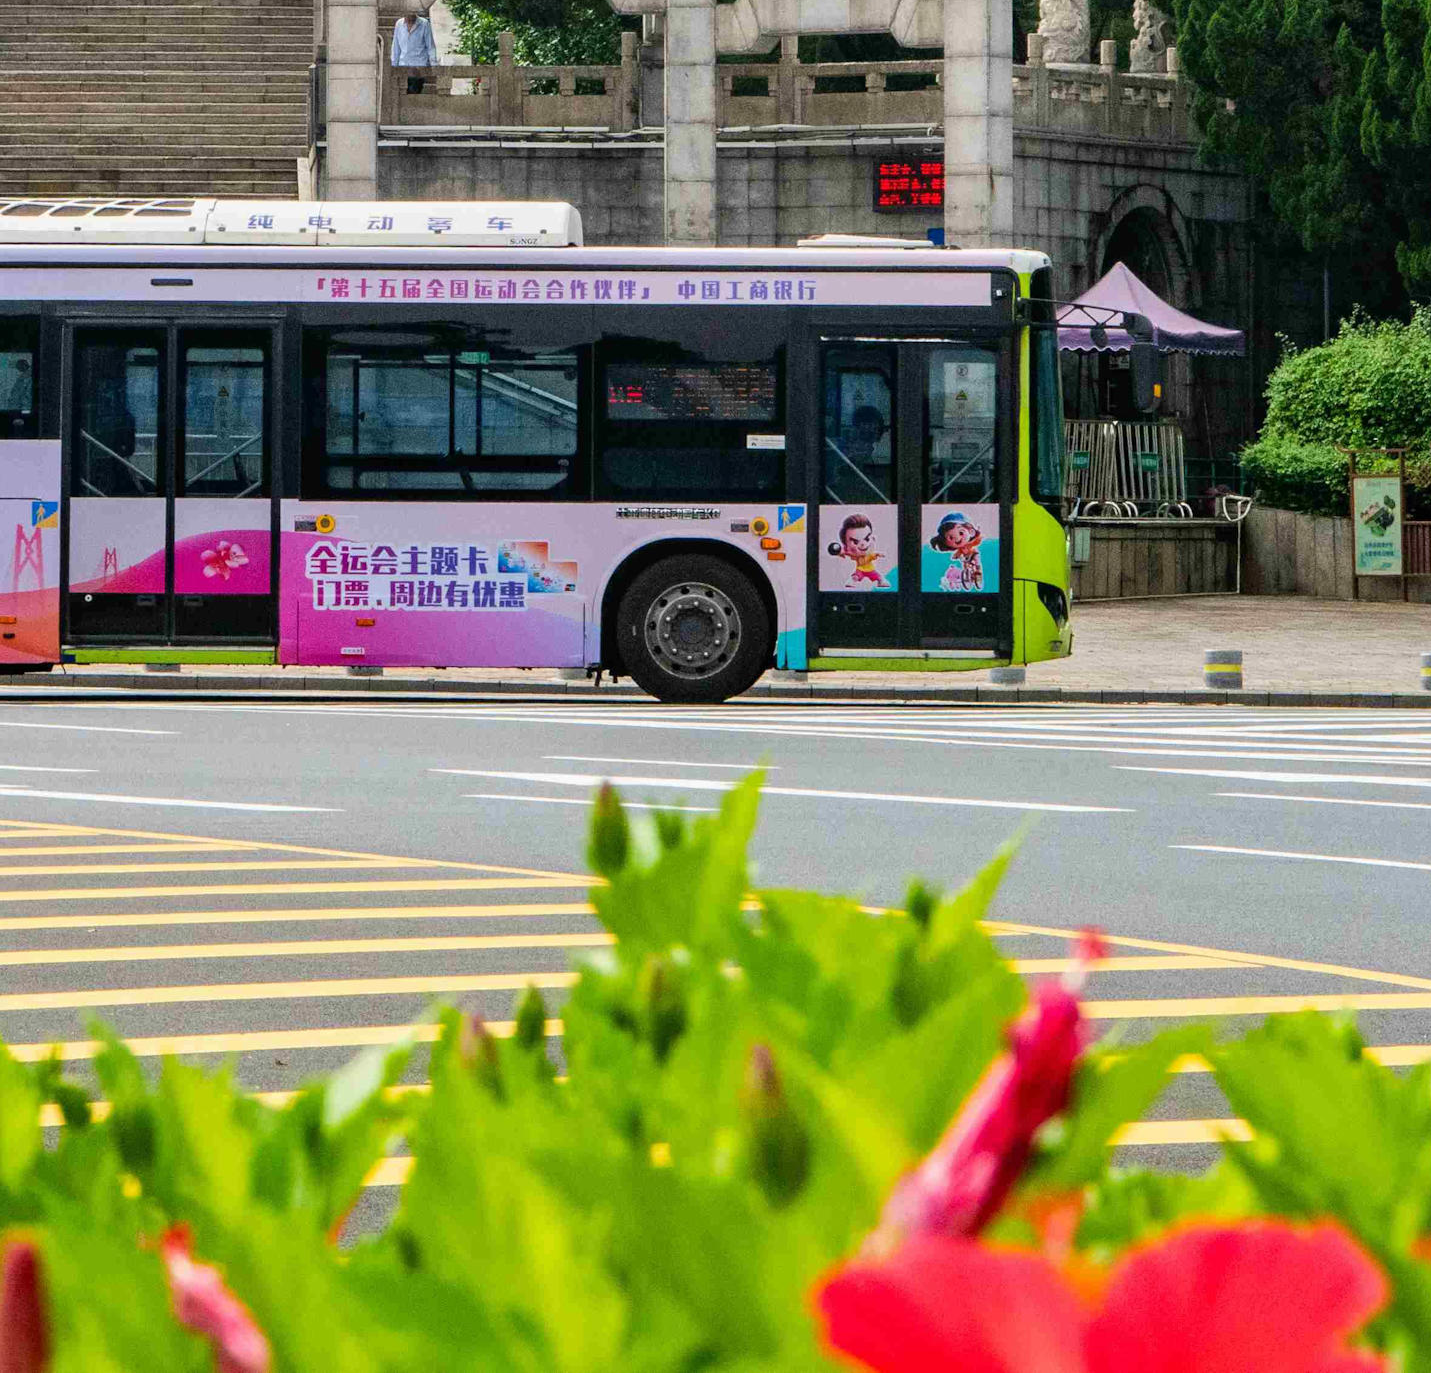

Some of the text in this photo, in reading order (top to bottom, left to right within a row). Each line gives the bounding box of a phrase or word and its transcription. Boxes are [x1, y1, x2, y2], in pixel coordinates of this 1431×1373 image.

[678, 279, 817, 301] 中国工商银行
[309, 545, 490, 577] 全运会主题卡
[316, 580, 526, 608] 门票、周边有优惠
